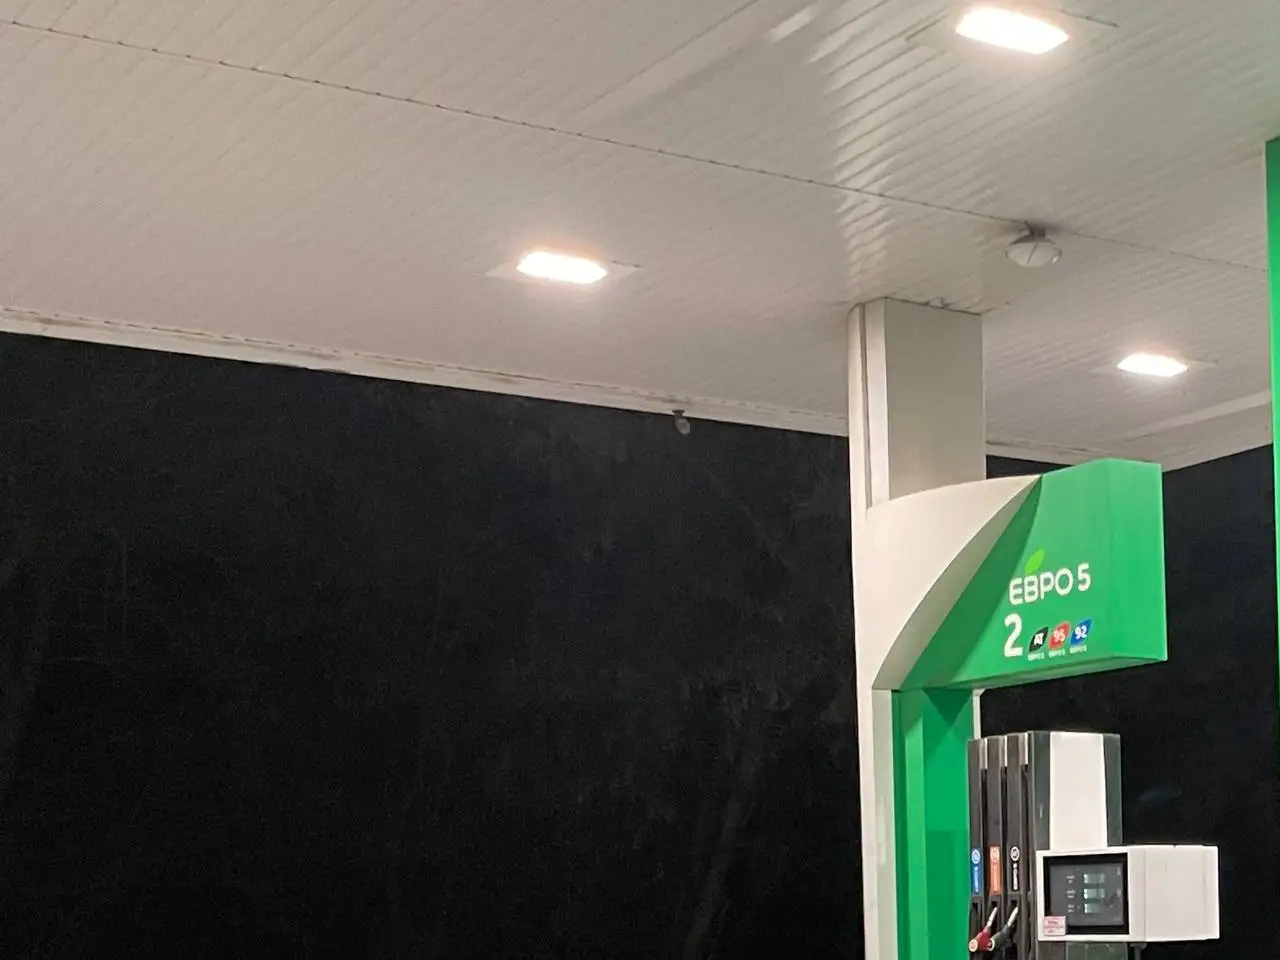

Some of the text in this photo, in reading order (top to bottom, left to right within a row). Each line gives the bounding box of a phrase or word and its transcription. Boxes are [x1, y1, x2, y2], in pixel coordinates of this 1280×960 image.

[1009, 563, 1091, 605] ЕВРО 5
[1004, 613, 1023, 657] 2
[1053, 628, 1066, 642] 95
[1074, 625, 1088, 640] 92
